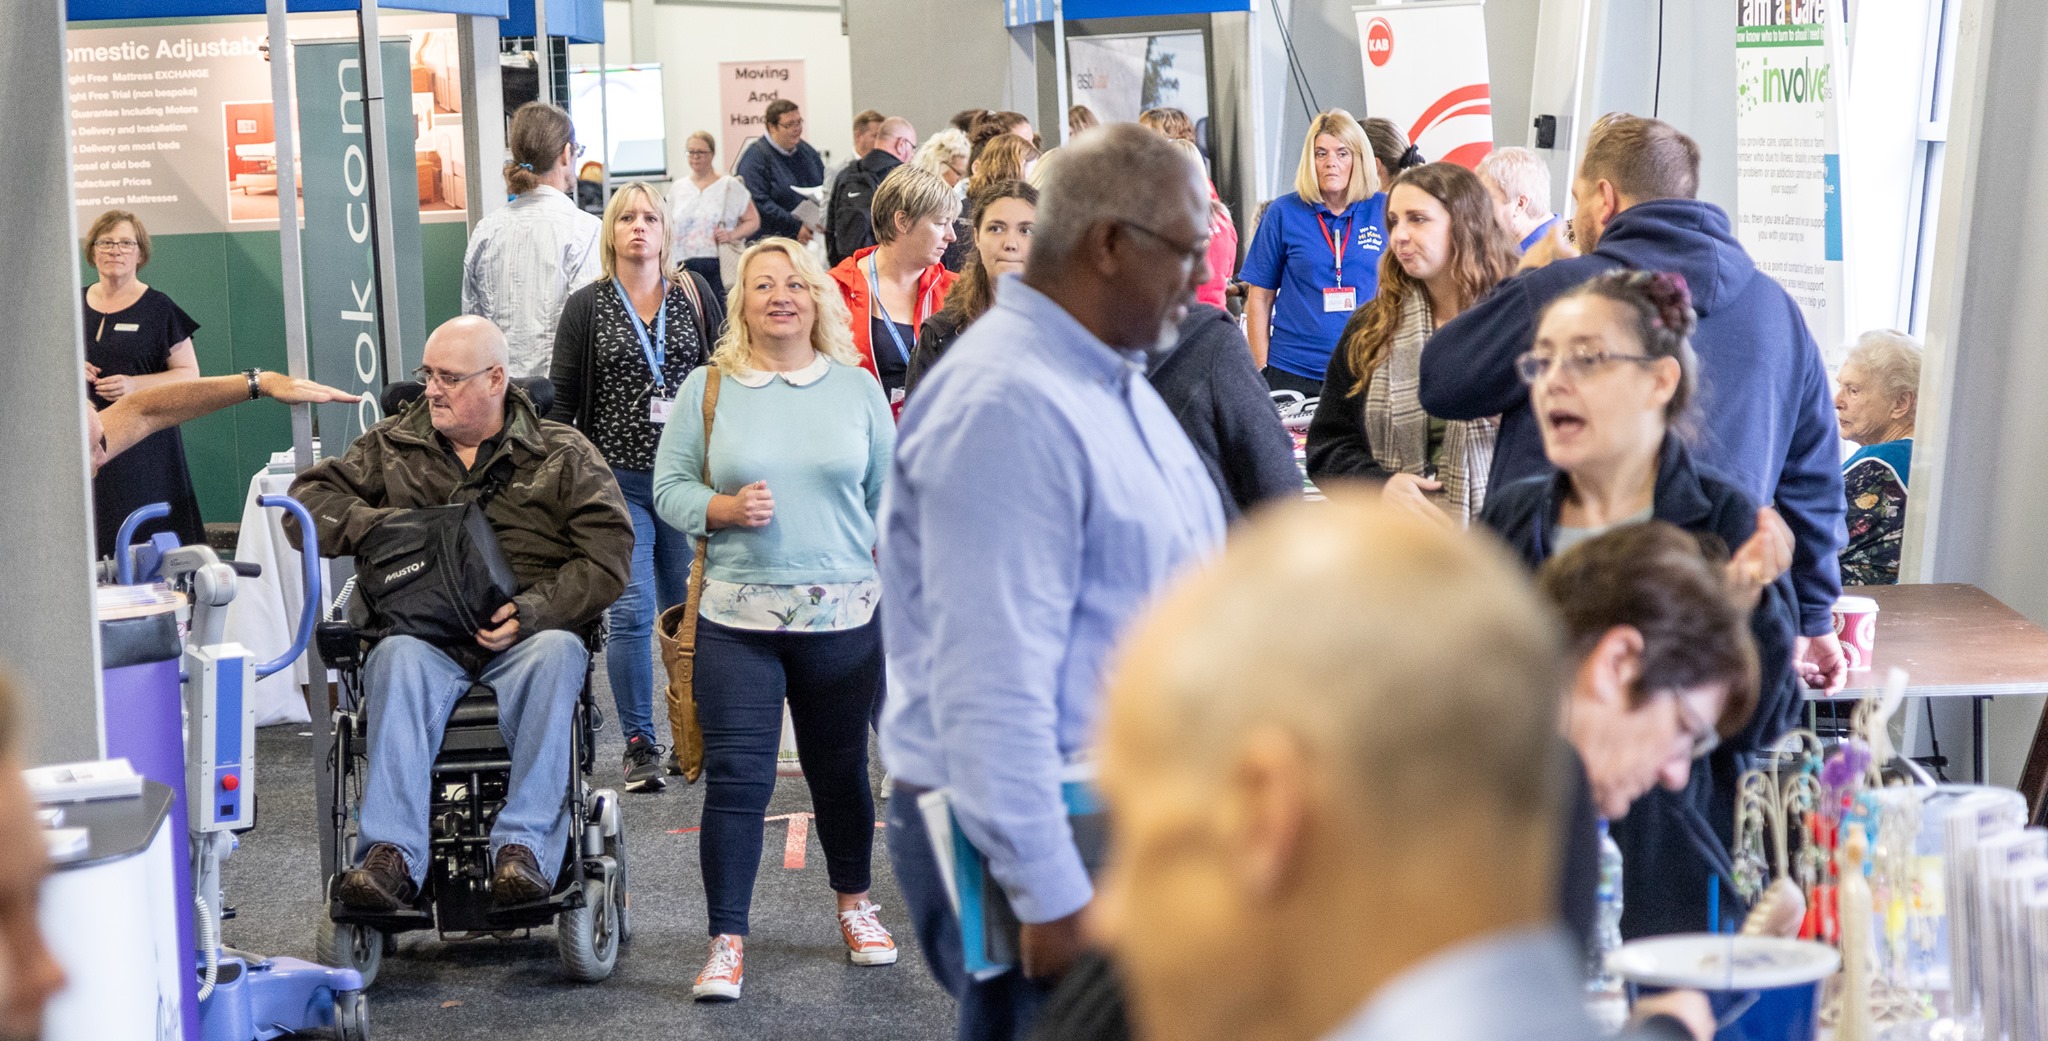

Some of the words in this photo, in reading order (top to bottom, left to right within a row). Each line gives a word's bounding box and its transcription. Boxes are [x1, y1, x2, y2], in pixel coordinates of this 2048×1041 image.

[1743, 0, 1772, 26] am
[1775, 0, 1786, 25] a
[1368, 38, 1390, 52] KAB
[87, 74, 109, 83] Free
[112, 72, 153, 81] Mattress
[154, 68, 209, 80] EXCHANGE
[735, 66, 789, 81] Moving
[87, 91, 109, 100] Free
[111, 89, 131, 99] Trial
[132, 88, 154, 100] (non
[154, 86, 198, 98] bespoke)
[747, 90, 779, 102] And
[71, 109, 120, 119] Guarantee
[120, 106, 164, 117] Including
[165, 105, 199, 114] Motors
[78, 126, 116, 136] Delivery
[117, 125, 135, 134] and
[136, 123, 188, 133] Installation
[79, 143, 116, 153] Delivery
[118, 144, 131, 152] on
[132, 142, 156, 151] most
[157, 141, 181, 150] beds
[99, 161, 110, 170] of
[111, 160, 127, 169] old
[127, 160, 151, 169] beds
[122, 178, 152, 186] Prices
[102, 195, 125, 205] Care
[126, 194, 178, 204] Mattresses
[1751, 214, 1763, 224] then
[1764, 215, 1773, 226] you
[384, 562, 420, 584] MUSTO
